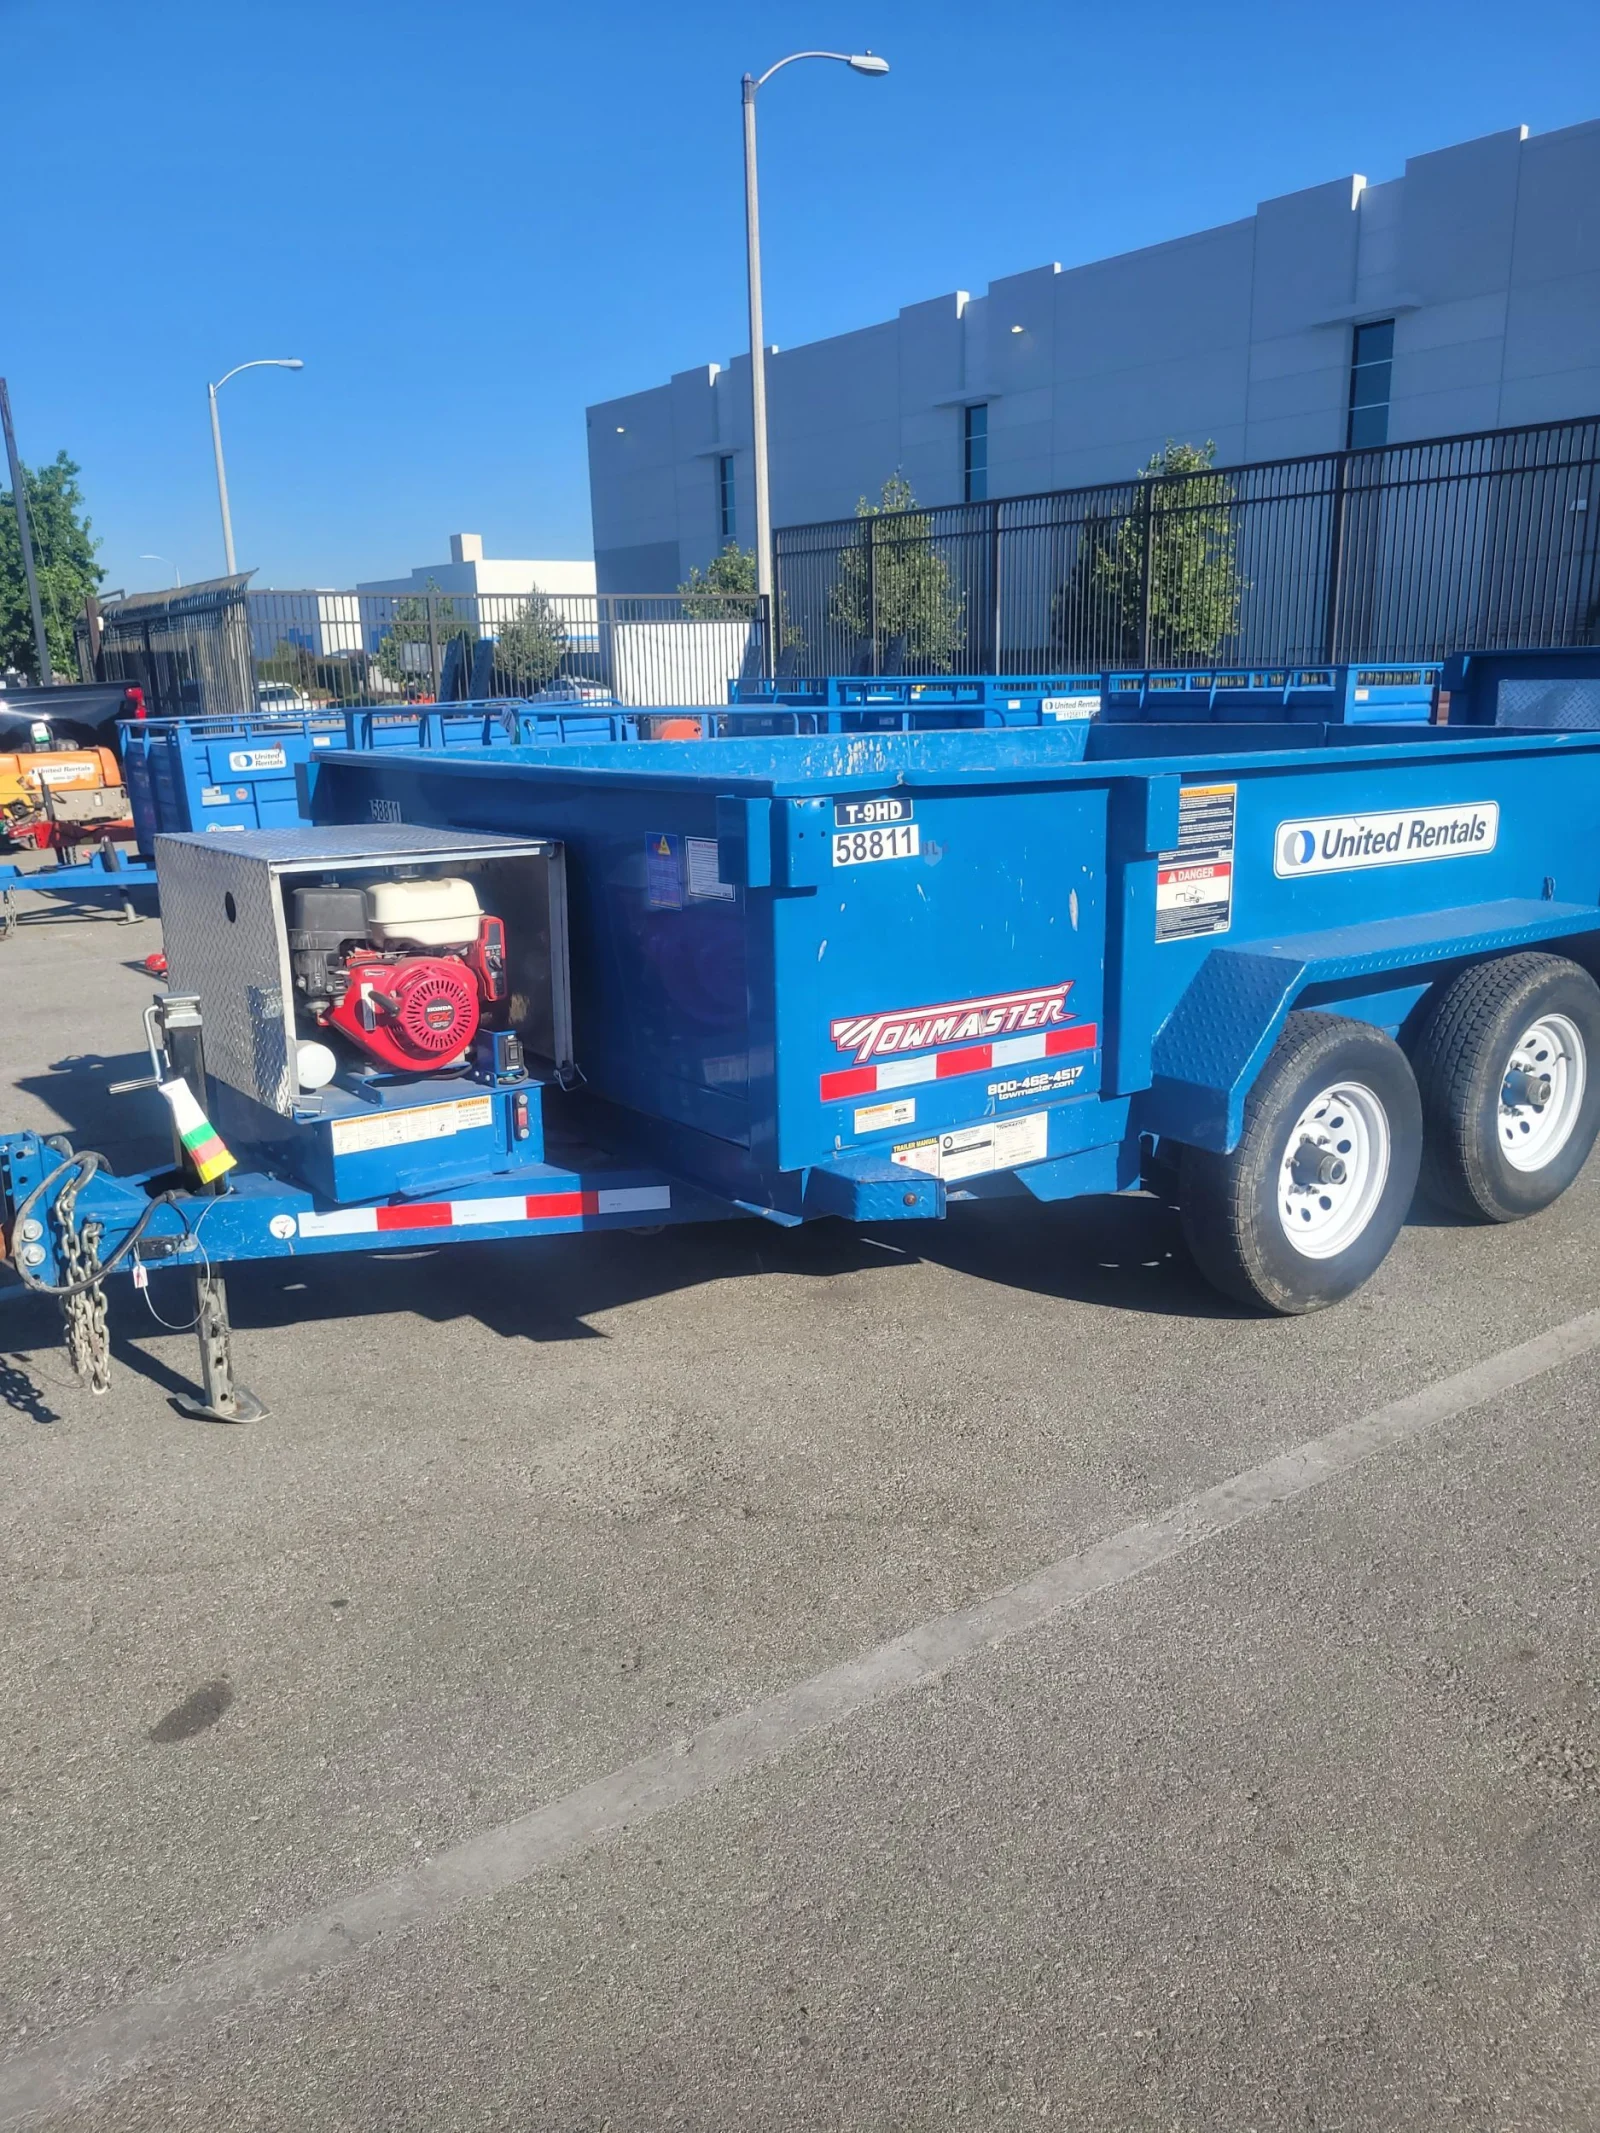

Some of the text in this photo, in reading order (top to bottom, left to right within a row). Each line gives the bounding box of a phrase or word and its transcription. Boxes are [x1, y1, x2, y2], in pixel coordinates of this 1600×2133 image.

[372, 800, 400, 823] 58811
[846, 801, 903, 823] T-9HD
[836, 827, 912, 864] 58811
[1321, 814, 1487, 860] United Rentals
[1177, 867, 1215, 882] DANGER
[427, 1005, 453, 1013] HONDA
[831, 981, 1076, 1063] TOWMASTER
[987, 1066, 1084, 1096] 800-462-4517
[998, 1079, 1075, 1101] towmaster.com
[893, 1137, 938, 1153] TRAILER MANUAL
